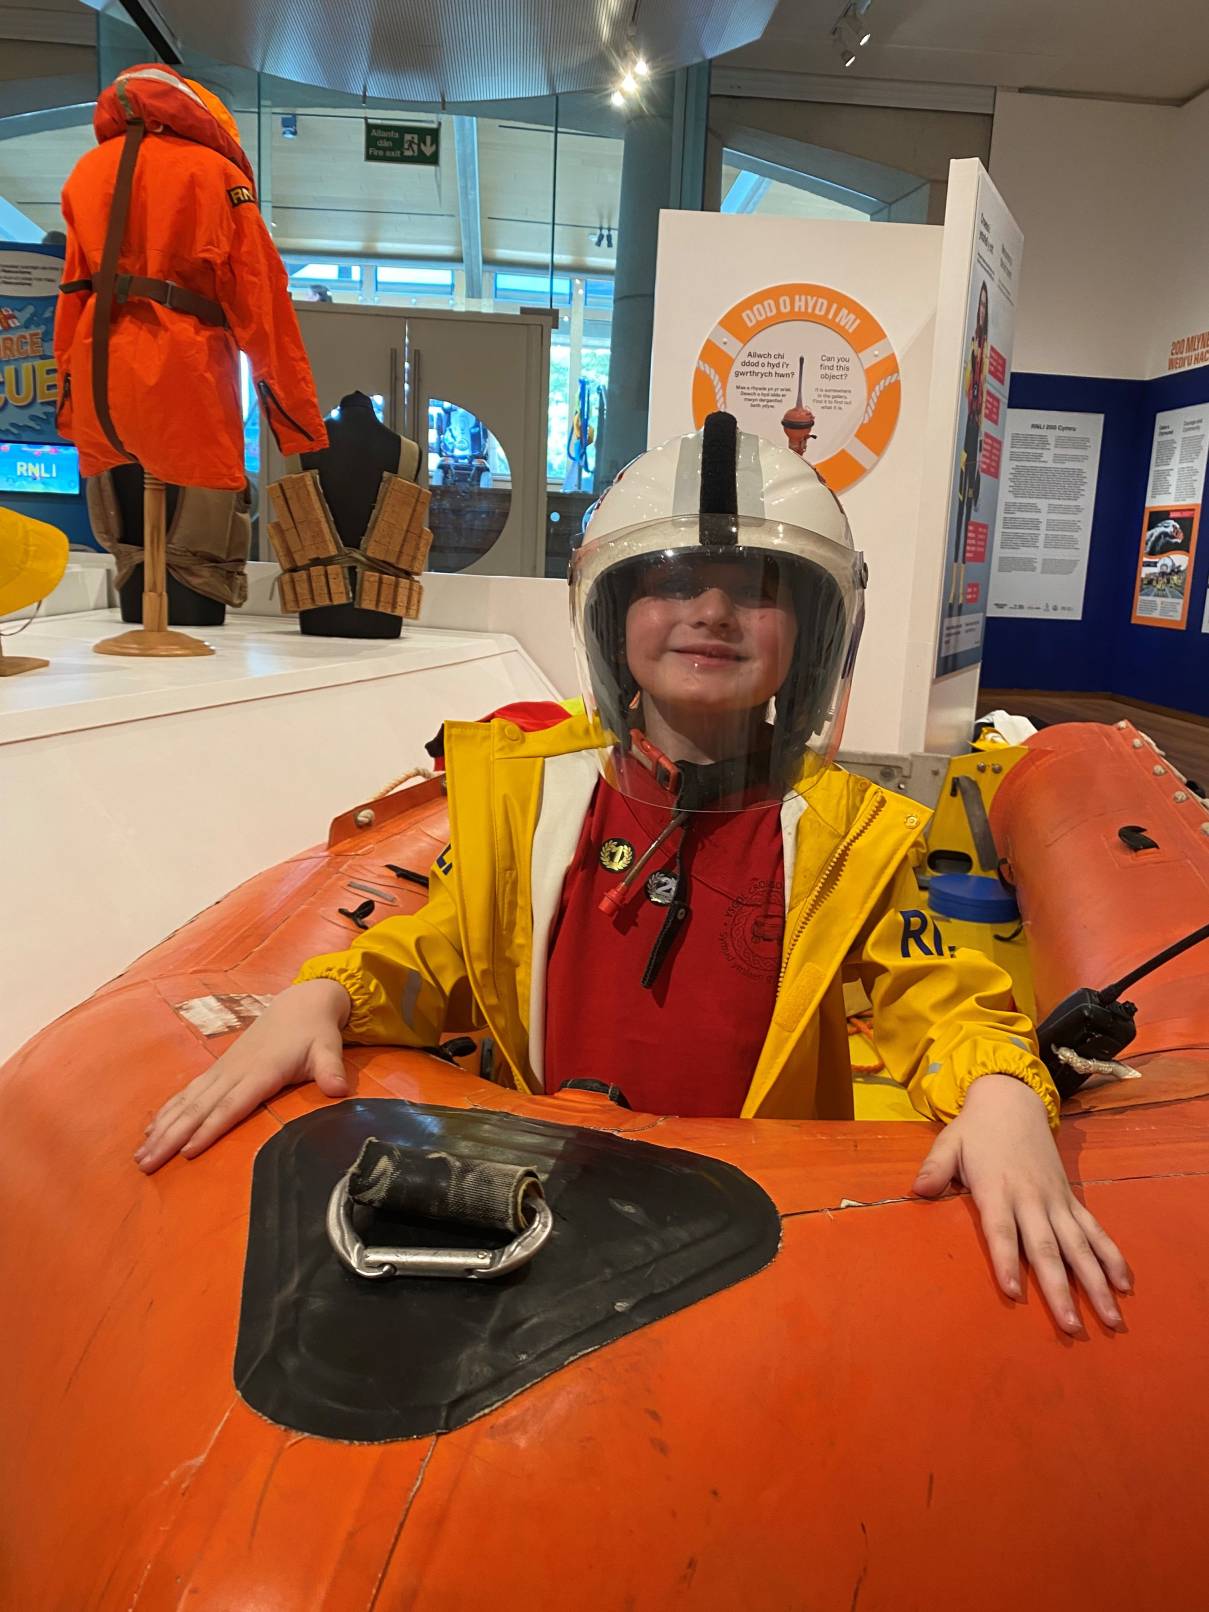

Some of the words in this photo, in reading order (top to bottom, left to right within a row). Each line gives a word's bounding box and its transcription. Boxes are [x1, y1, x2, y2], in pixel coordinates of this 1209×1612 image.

[369, 147, 383, 156] Fire
[385, 149, 401, 157] exit
[742, 298, 777, 328] DOD
[794, 294, 828, 316] HYD
[835, 307, 861, 333] MI
[0, 332, 42, 360] RCE
[747, 351, 772, 360] Allwch
[773, 352, 785, 360] chi
[821, 354, 836, 362] Can
[837, 356, 850, 364] you
[741, 360, 760, 368] ddod
[767, 361, 781, 370] hyd
[820, 363, 835, 372] find
[836, 364, 850, 372] this
[735, 370, 773, 379] gwrthrych
[775, 370, 796, 379] hwn?
[820, 373, 848, 381] object?
[0, 359, 58, 406] UE
[16, 461, 57, 478] RNLI
